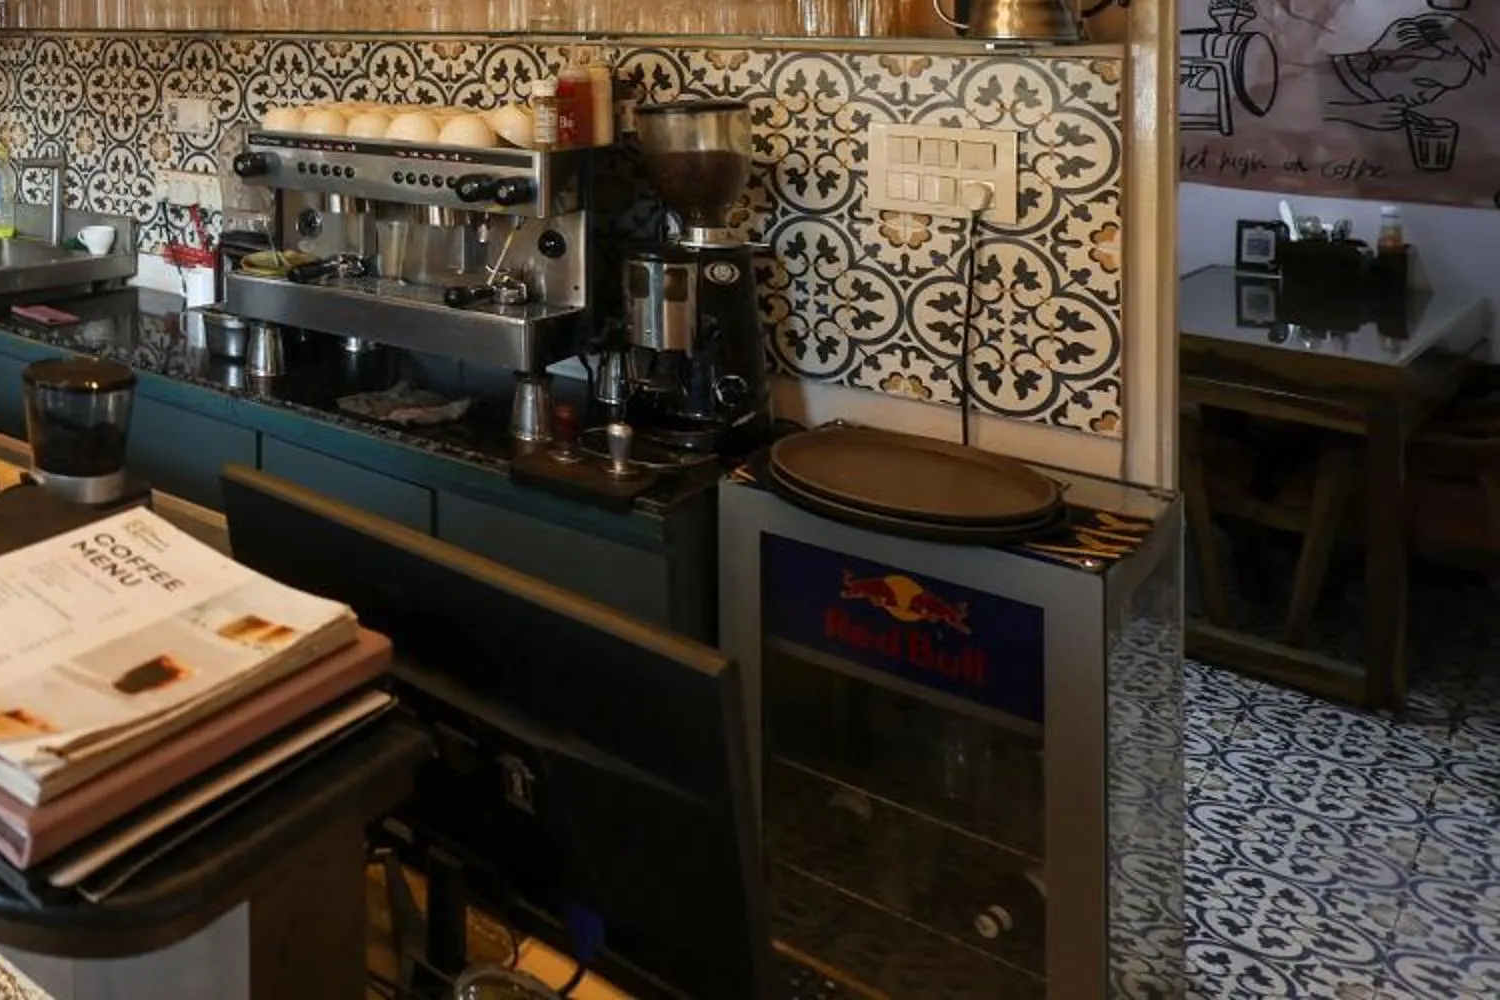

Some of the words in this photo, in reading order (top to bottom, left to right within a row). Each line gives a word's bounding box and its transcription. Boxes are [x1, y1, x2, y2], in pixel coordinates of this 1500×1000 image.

[70, 541, 142, 586] MENU
[94, 533, 185, 592] COFFEE
[824, 607, 902, 657] Red
[909, 630, 988, 685] Bull
